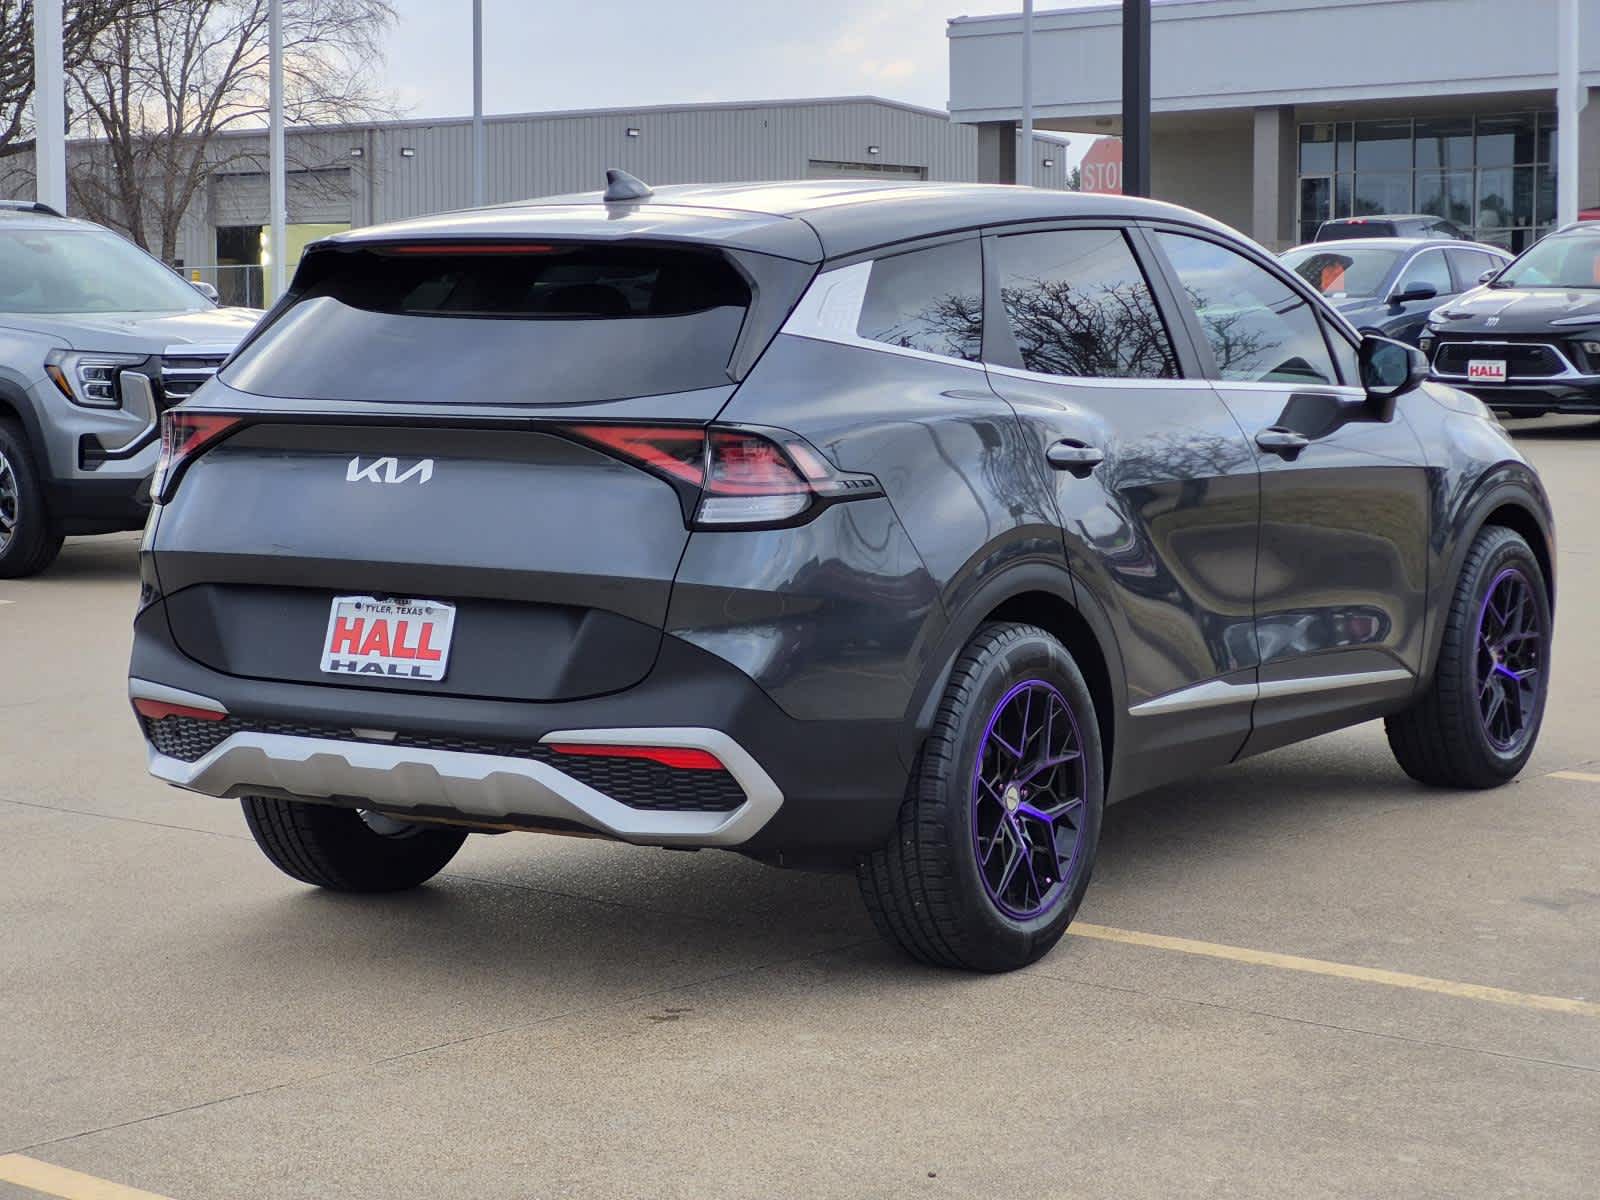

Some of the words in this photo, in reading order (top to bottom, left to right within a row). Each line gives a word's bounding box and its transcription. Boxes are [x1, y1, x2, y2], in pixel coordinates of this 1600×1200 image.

[1084, 161, 1123, 191] STO
[1470, 365, 1504, 377] HALL
[346, 456, 434, 484] KIA
[366, 604, 393, 615] TYLER,
[396, 606, 423, 616] TEXAS
[330, 616, 442, 661] HALL
[330, 659, 433, 678] HALL
